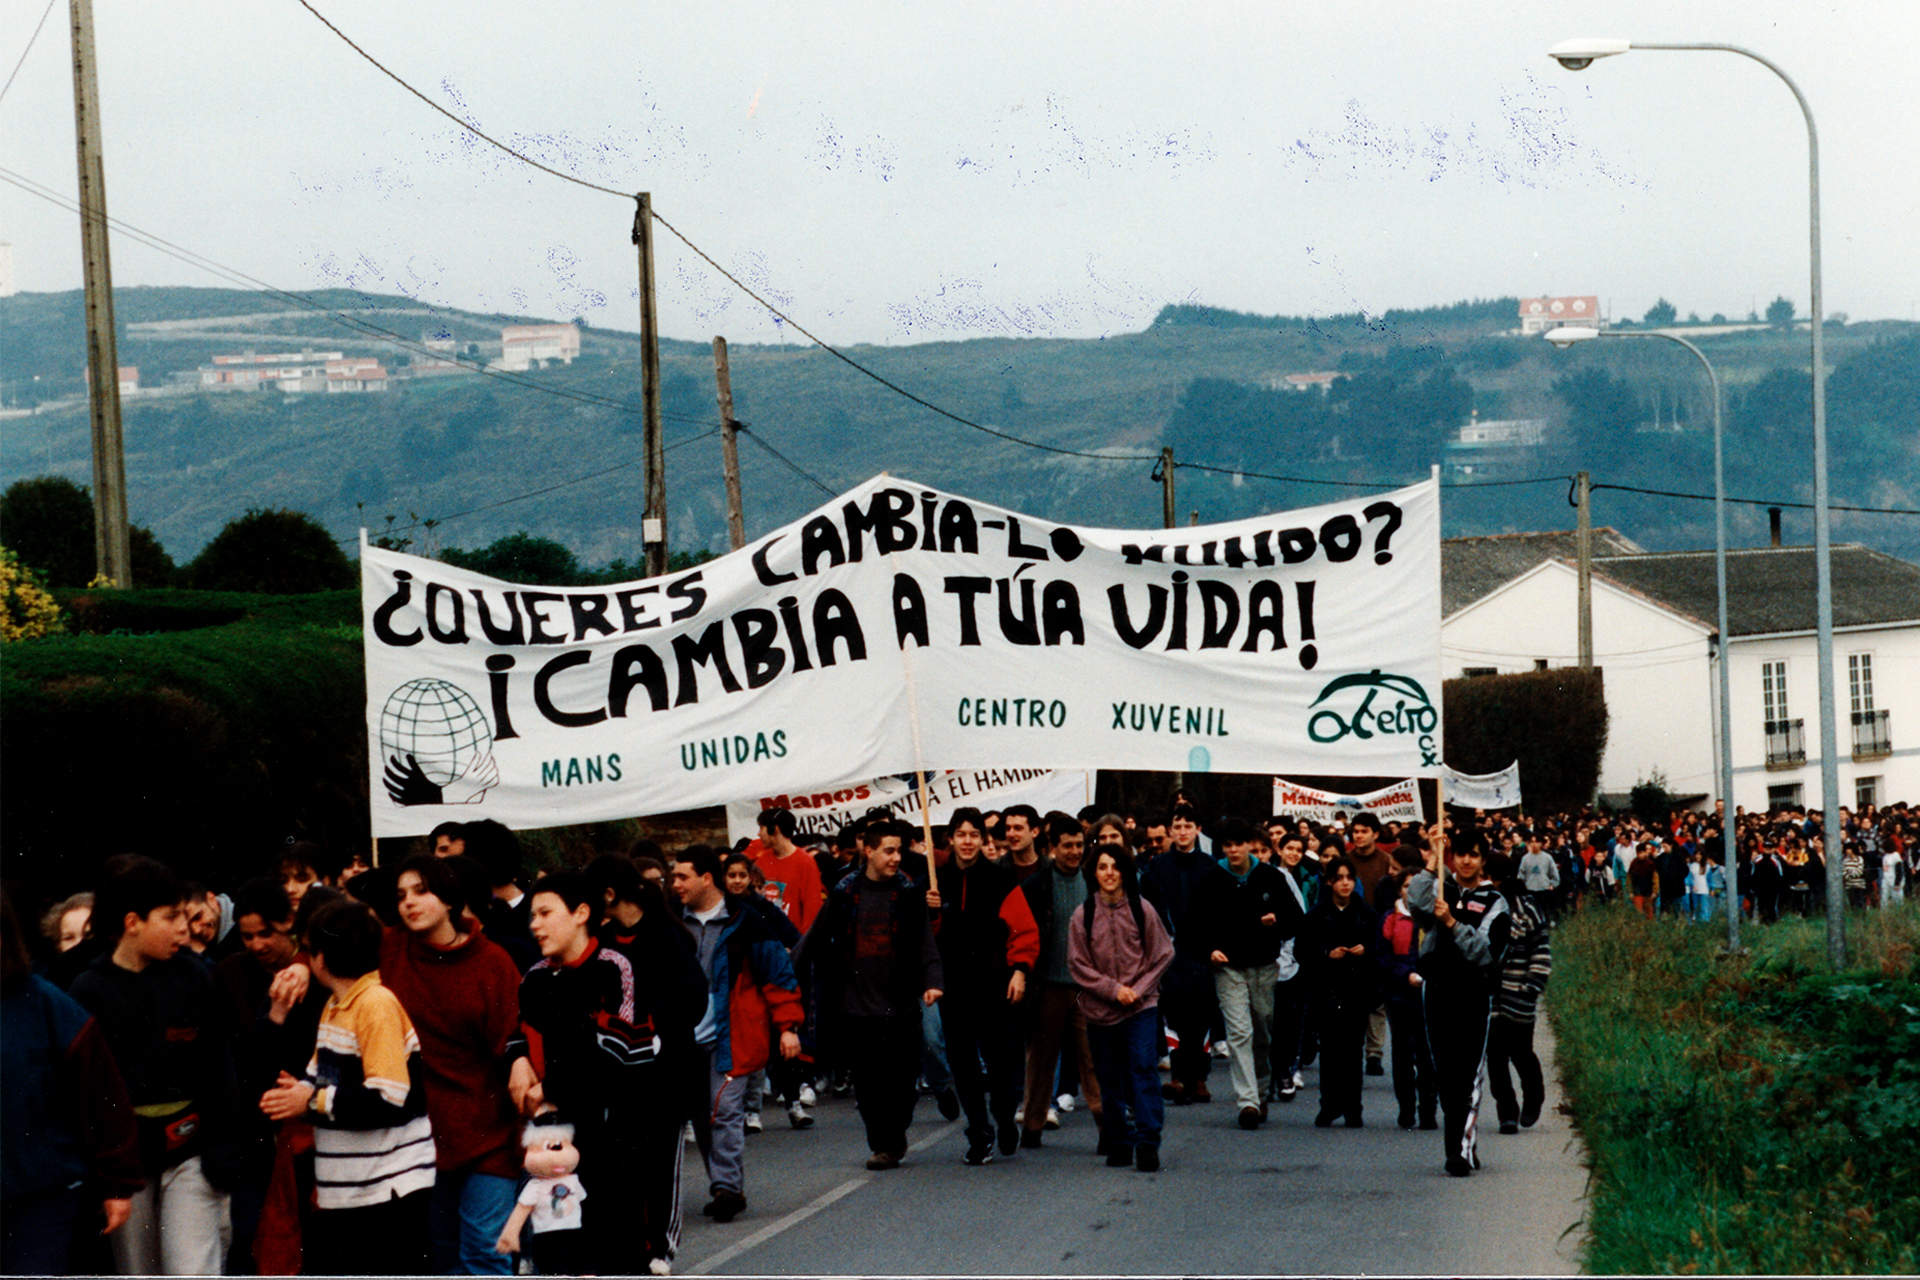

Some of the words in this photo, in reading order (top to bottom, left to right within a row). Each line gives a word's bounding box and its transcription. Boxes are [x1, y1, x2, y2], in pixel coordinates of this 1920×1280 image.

[373, 569, 707, 647] ¿QUERES
[892, 572, 930, 650] A
[943, 562, 1086, 647] TÚA
[1106, 569, 1319, 671] VIDA!
[958, 697, 1067, 728] CENTRO
[1112, 701, 1229, 737] XUVENIL
[541, 753, 623, 788] MANS
[681, 729, 788, 771] UNIDAS
[759, 784, 871, 812] Manos
[793, 807, 856, 836] MPAÑA
[947, 776, 971, 800] EL
